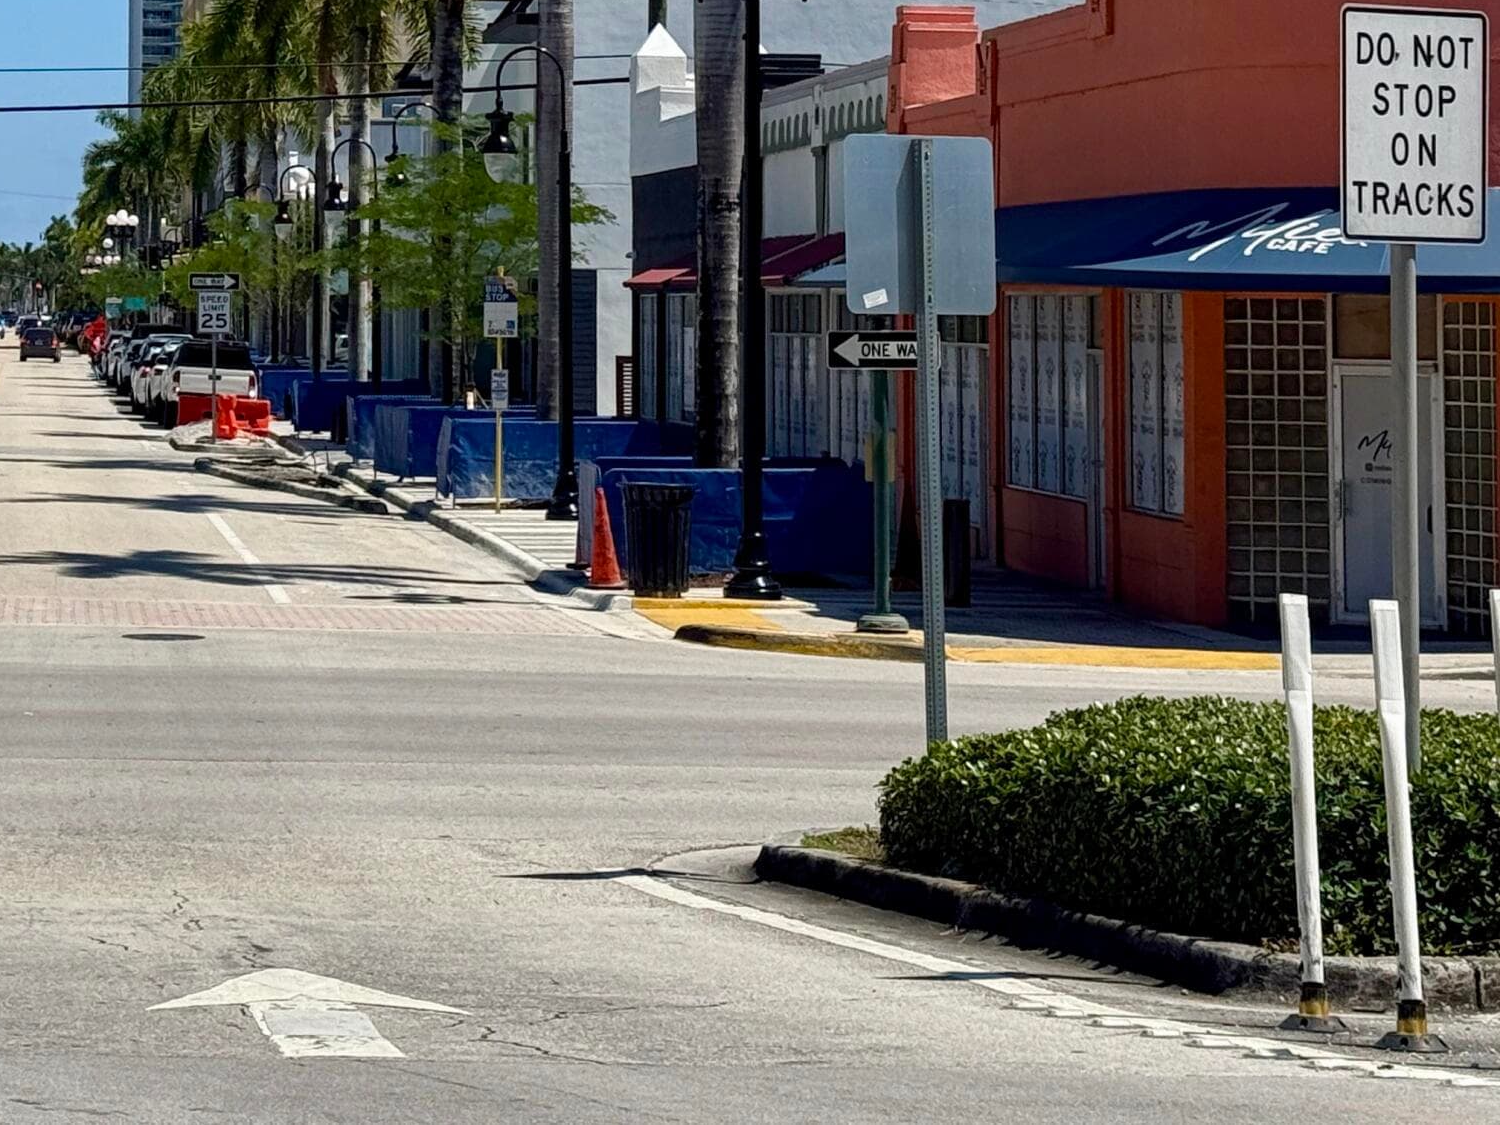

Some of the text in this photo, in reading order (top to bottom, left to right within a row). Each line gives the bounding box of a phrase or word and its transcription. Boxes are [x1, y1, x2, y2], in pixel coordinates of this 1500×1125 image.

[1356, 32, 1474, 70] DO NOT
[1372, 82, 1456, 118] STOP
[1391, 132, 1437, 167] ON
[1352, 180, 1475, 218] TRACKS
[1266, 238, 1335, 255] CAFE
[200, 295, 229, 304] SPEED
[485, 294, 510, 302] STOP
[202, 304, 225, 312] LIMIT
[201, 313, 228, 329] 25
[861, 343, 917, 357] ONE WA
